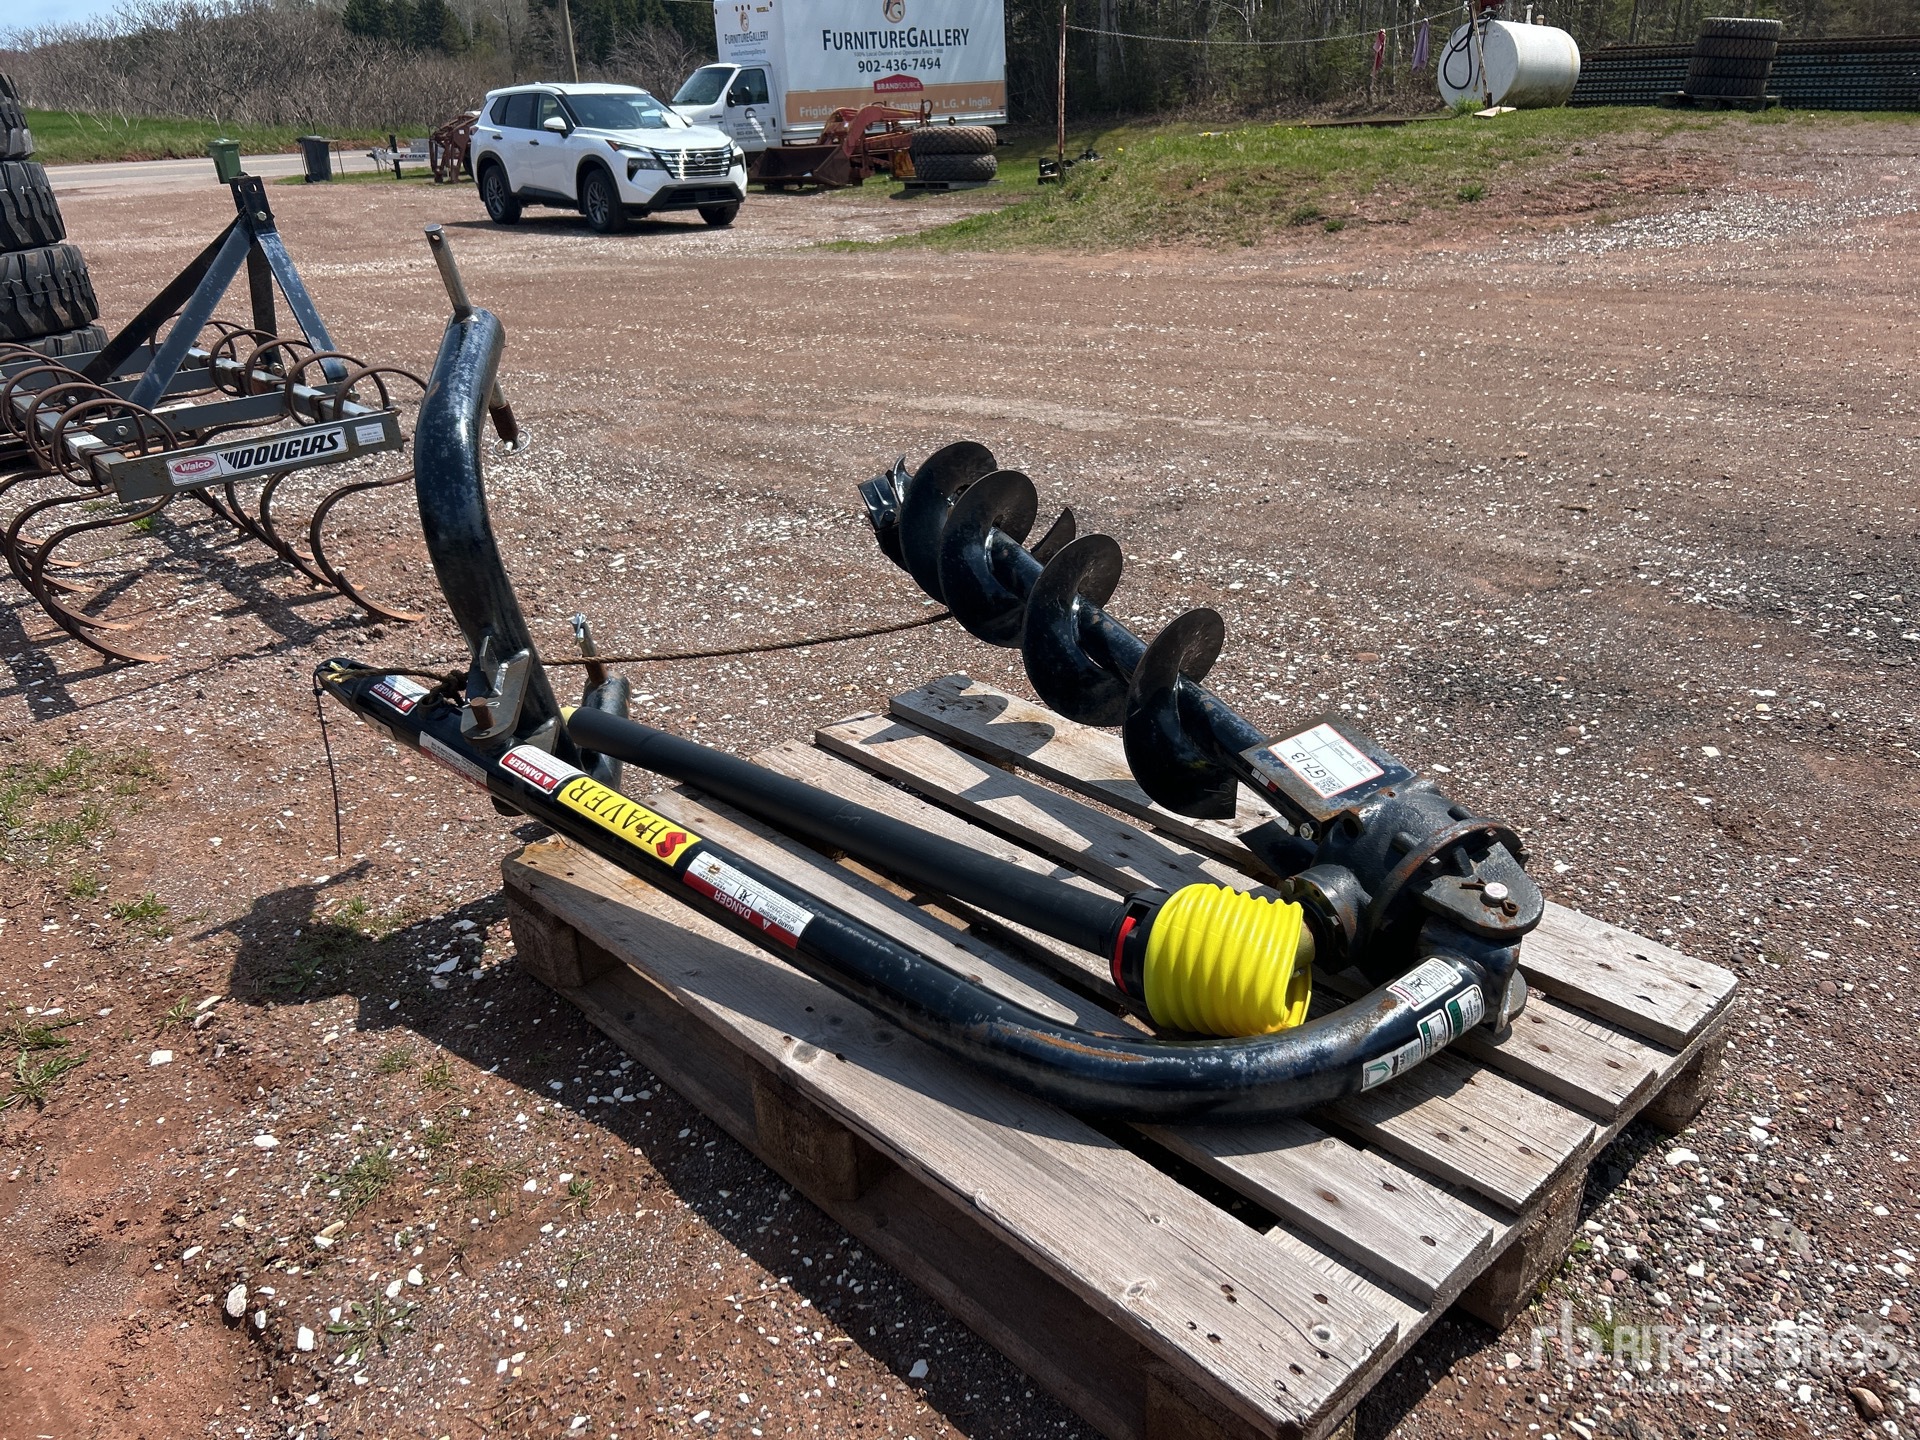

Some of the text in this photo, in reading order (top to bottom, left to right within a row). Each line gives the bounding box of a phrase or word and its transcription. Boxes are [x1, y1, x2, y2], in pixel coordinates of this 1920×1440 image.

[858, 57, 942, 72] 902-436-7494
[876, 82, 920, 90] BRANDSOURCE
[968, 96, 992, 109] Inglis
[180, 431, 341, 472] Walco DOUGLAS
[373, 683, 402, 704] DANGER
[502, 756, 544, 781] DANGER
[568, 780, 687, 858] SHAVER
[714, 890, 752, 920] DANGER
[758, 907, 778, 921] MISSING
[778, 918, 795, 932] GUARD
